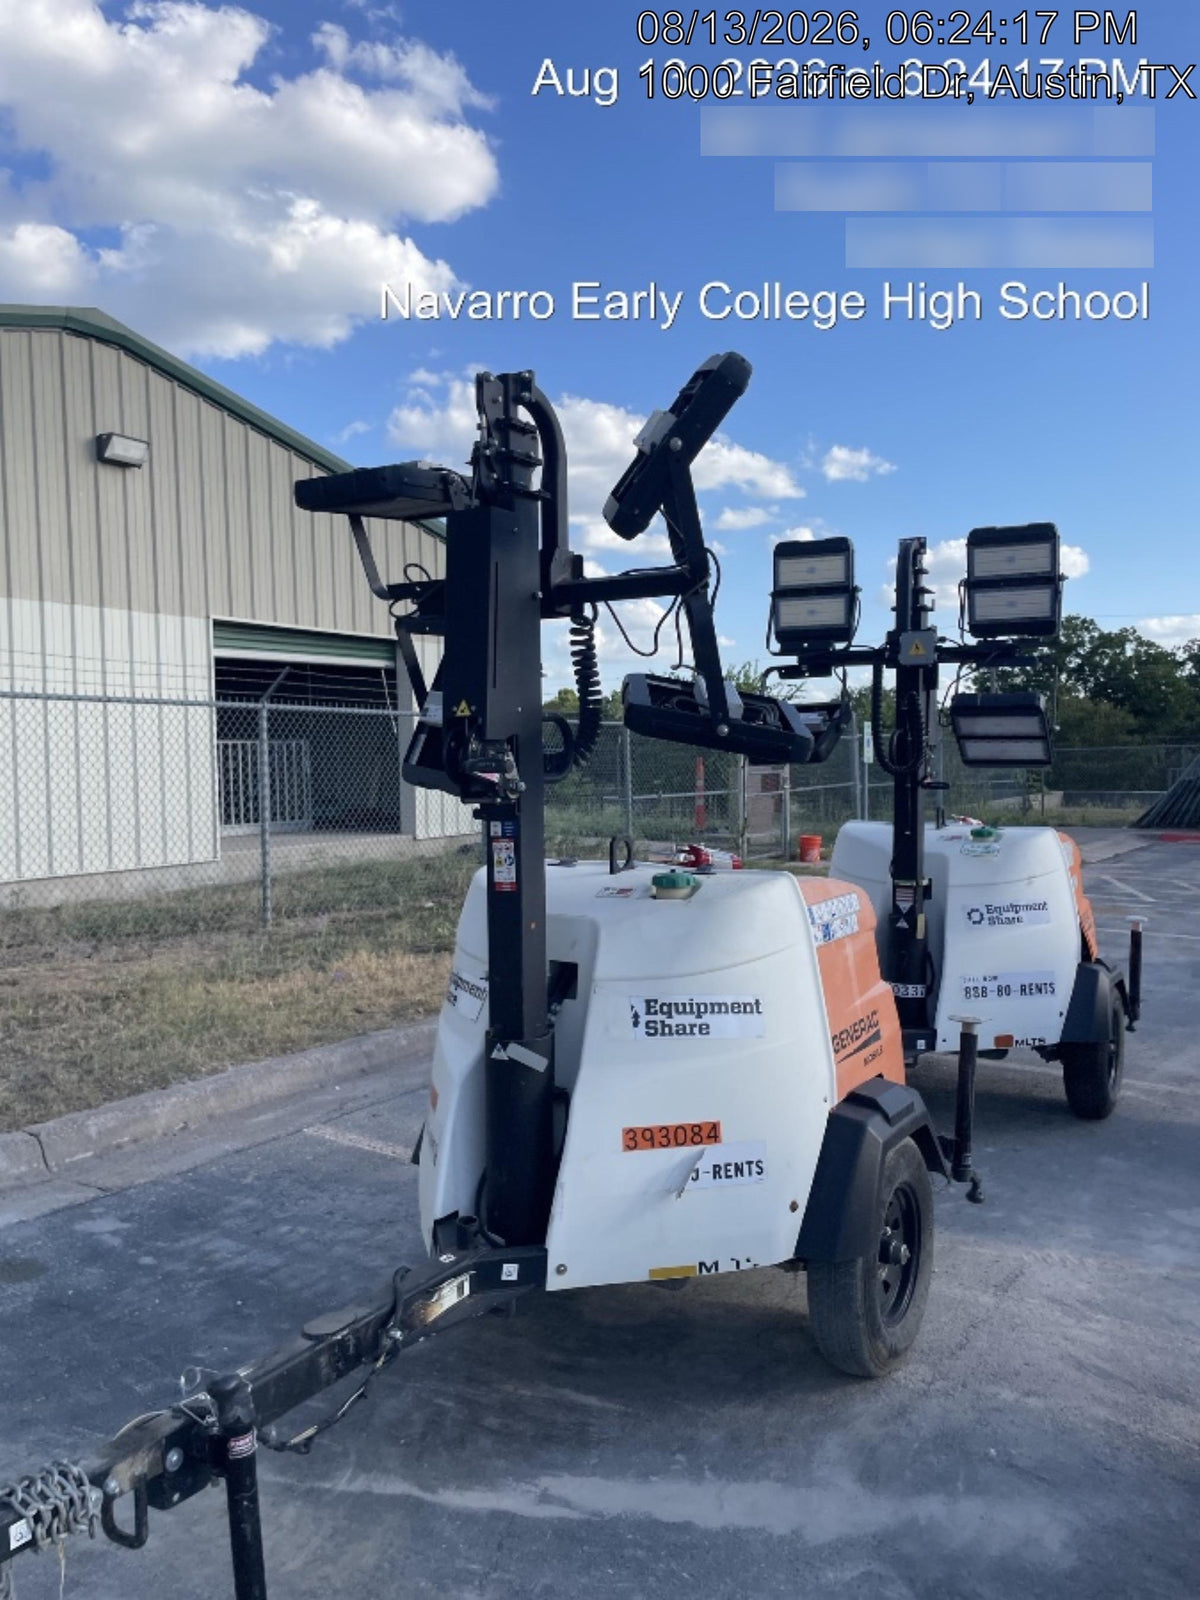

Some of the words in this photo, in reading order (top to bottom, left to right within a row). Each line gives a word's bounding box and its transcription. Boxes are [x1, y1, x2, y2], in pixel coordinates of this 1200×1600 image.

[985, 902, 1048, 917] Equipment
[644, 998, 763, 1019] Equipment
[644, 1020, 710, 1037] Share
[832, 1009, 879, 1054] GENERAC
[625, 1120, 720, 1151] 393084
